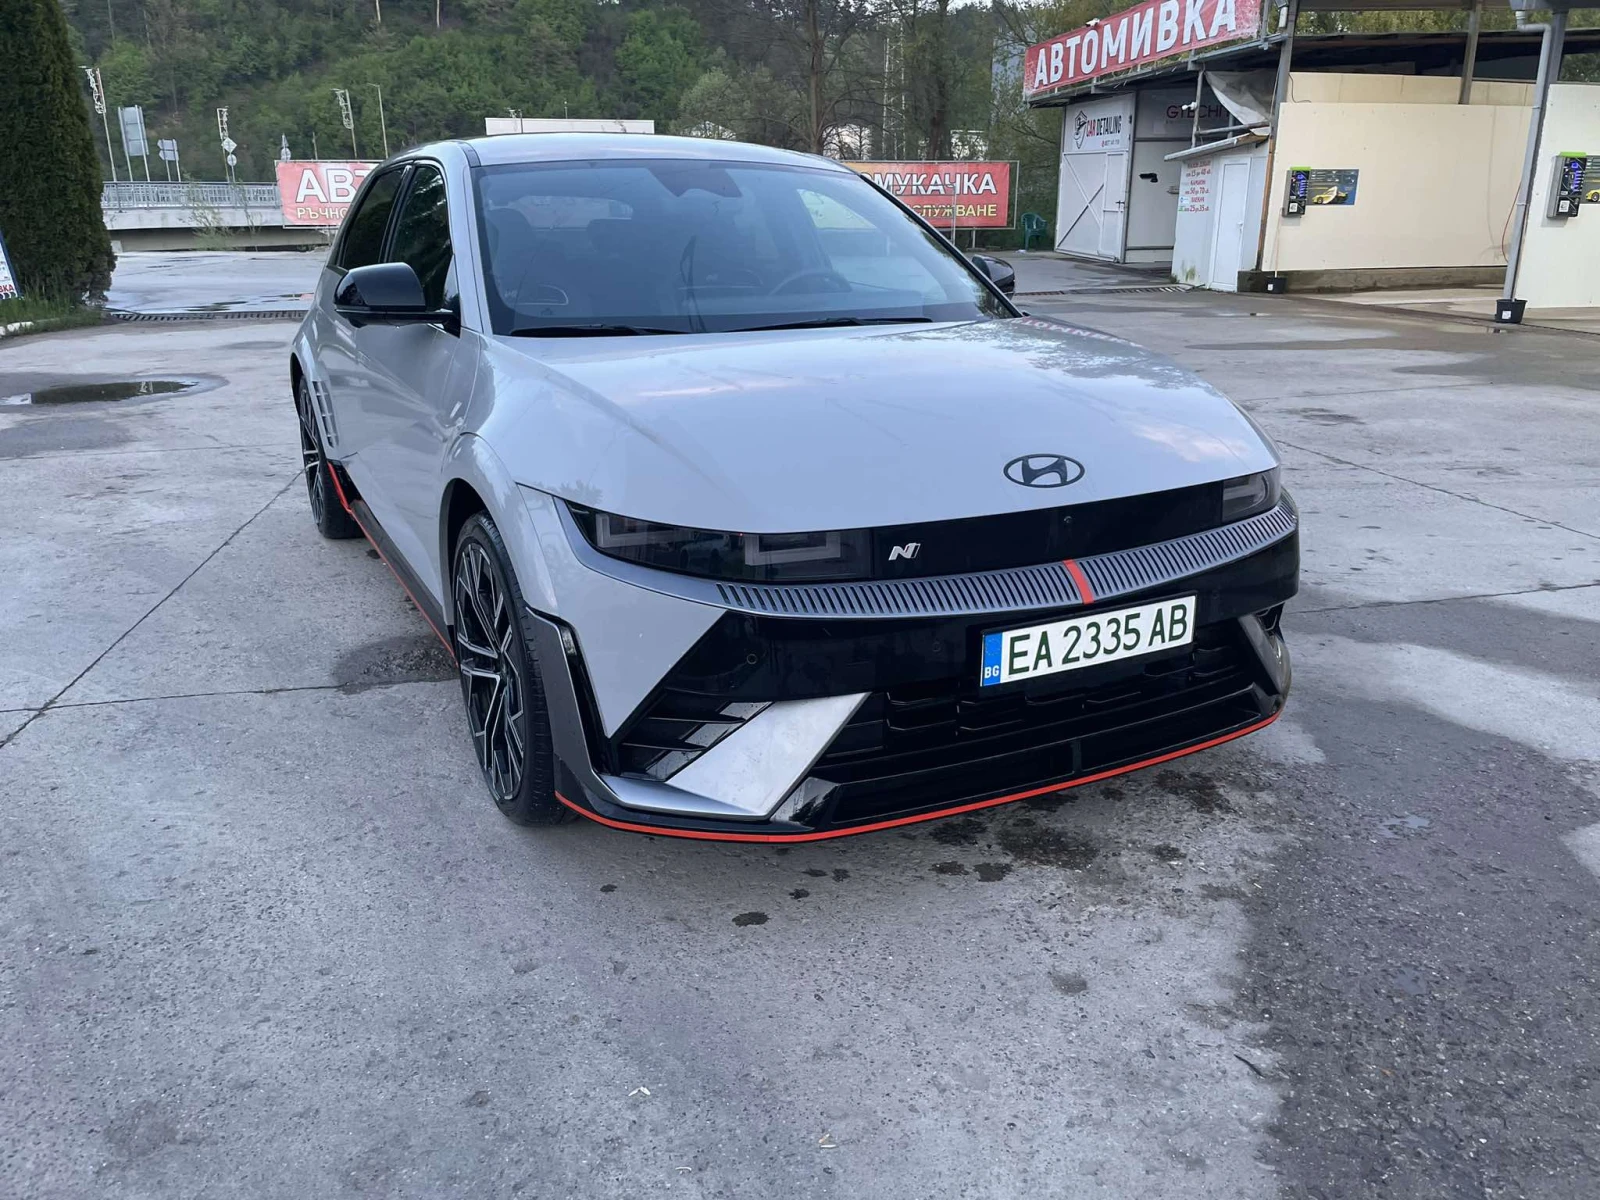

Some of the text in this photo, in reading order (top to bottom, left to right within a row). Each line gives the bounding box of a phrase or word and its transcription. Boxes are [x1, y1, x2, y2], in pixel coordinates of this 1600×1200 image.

[1033, 0, 1237, 89] АВТОМИВКА
[1086, 115, 1122, 137] CAR DETAILING
[1008, 603, 1188, 675] EA 2335 AB
[984, 664, 1000, 679] BG
